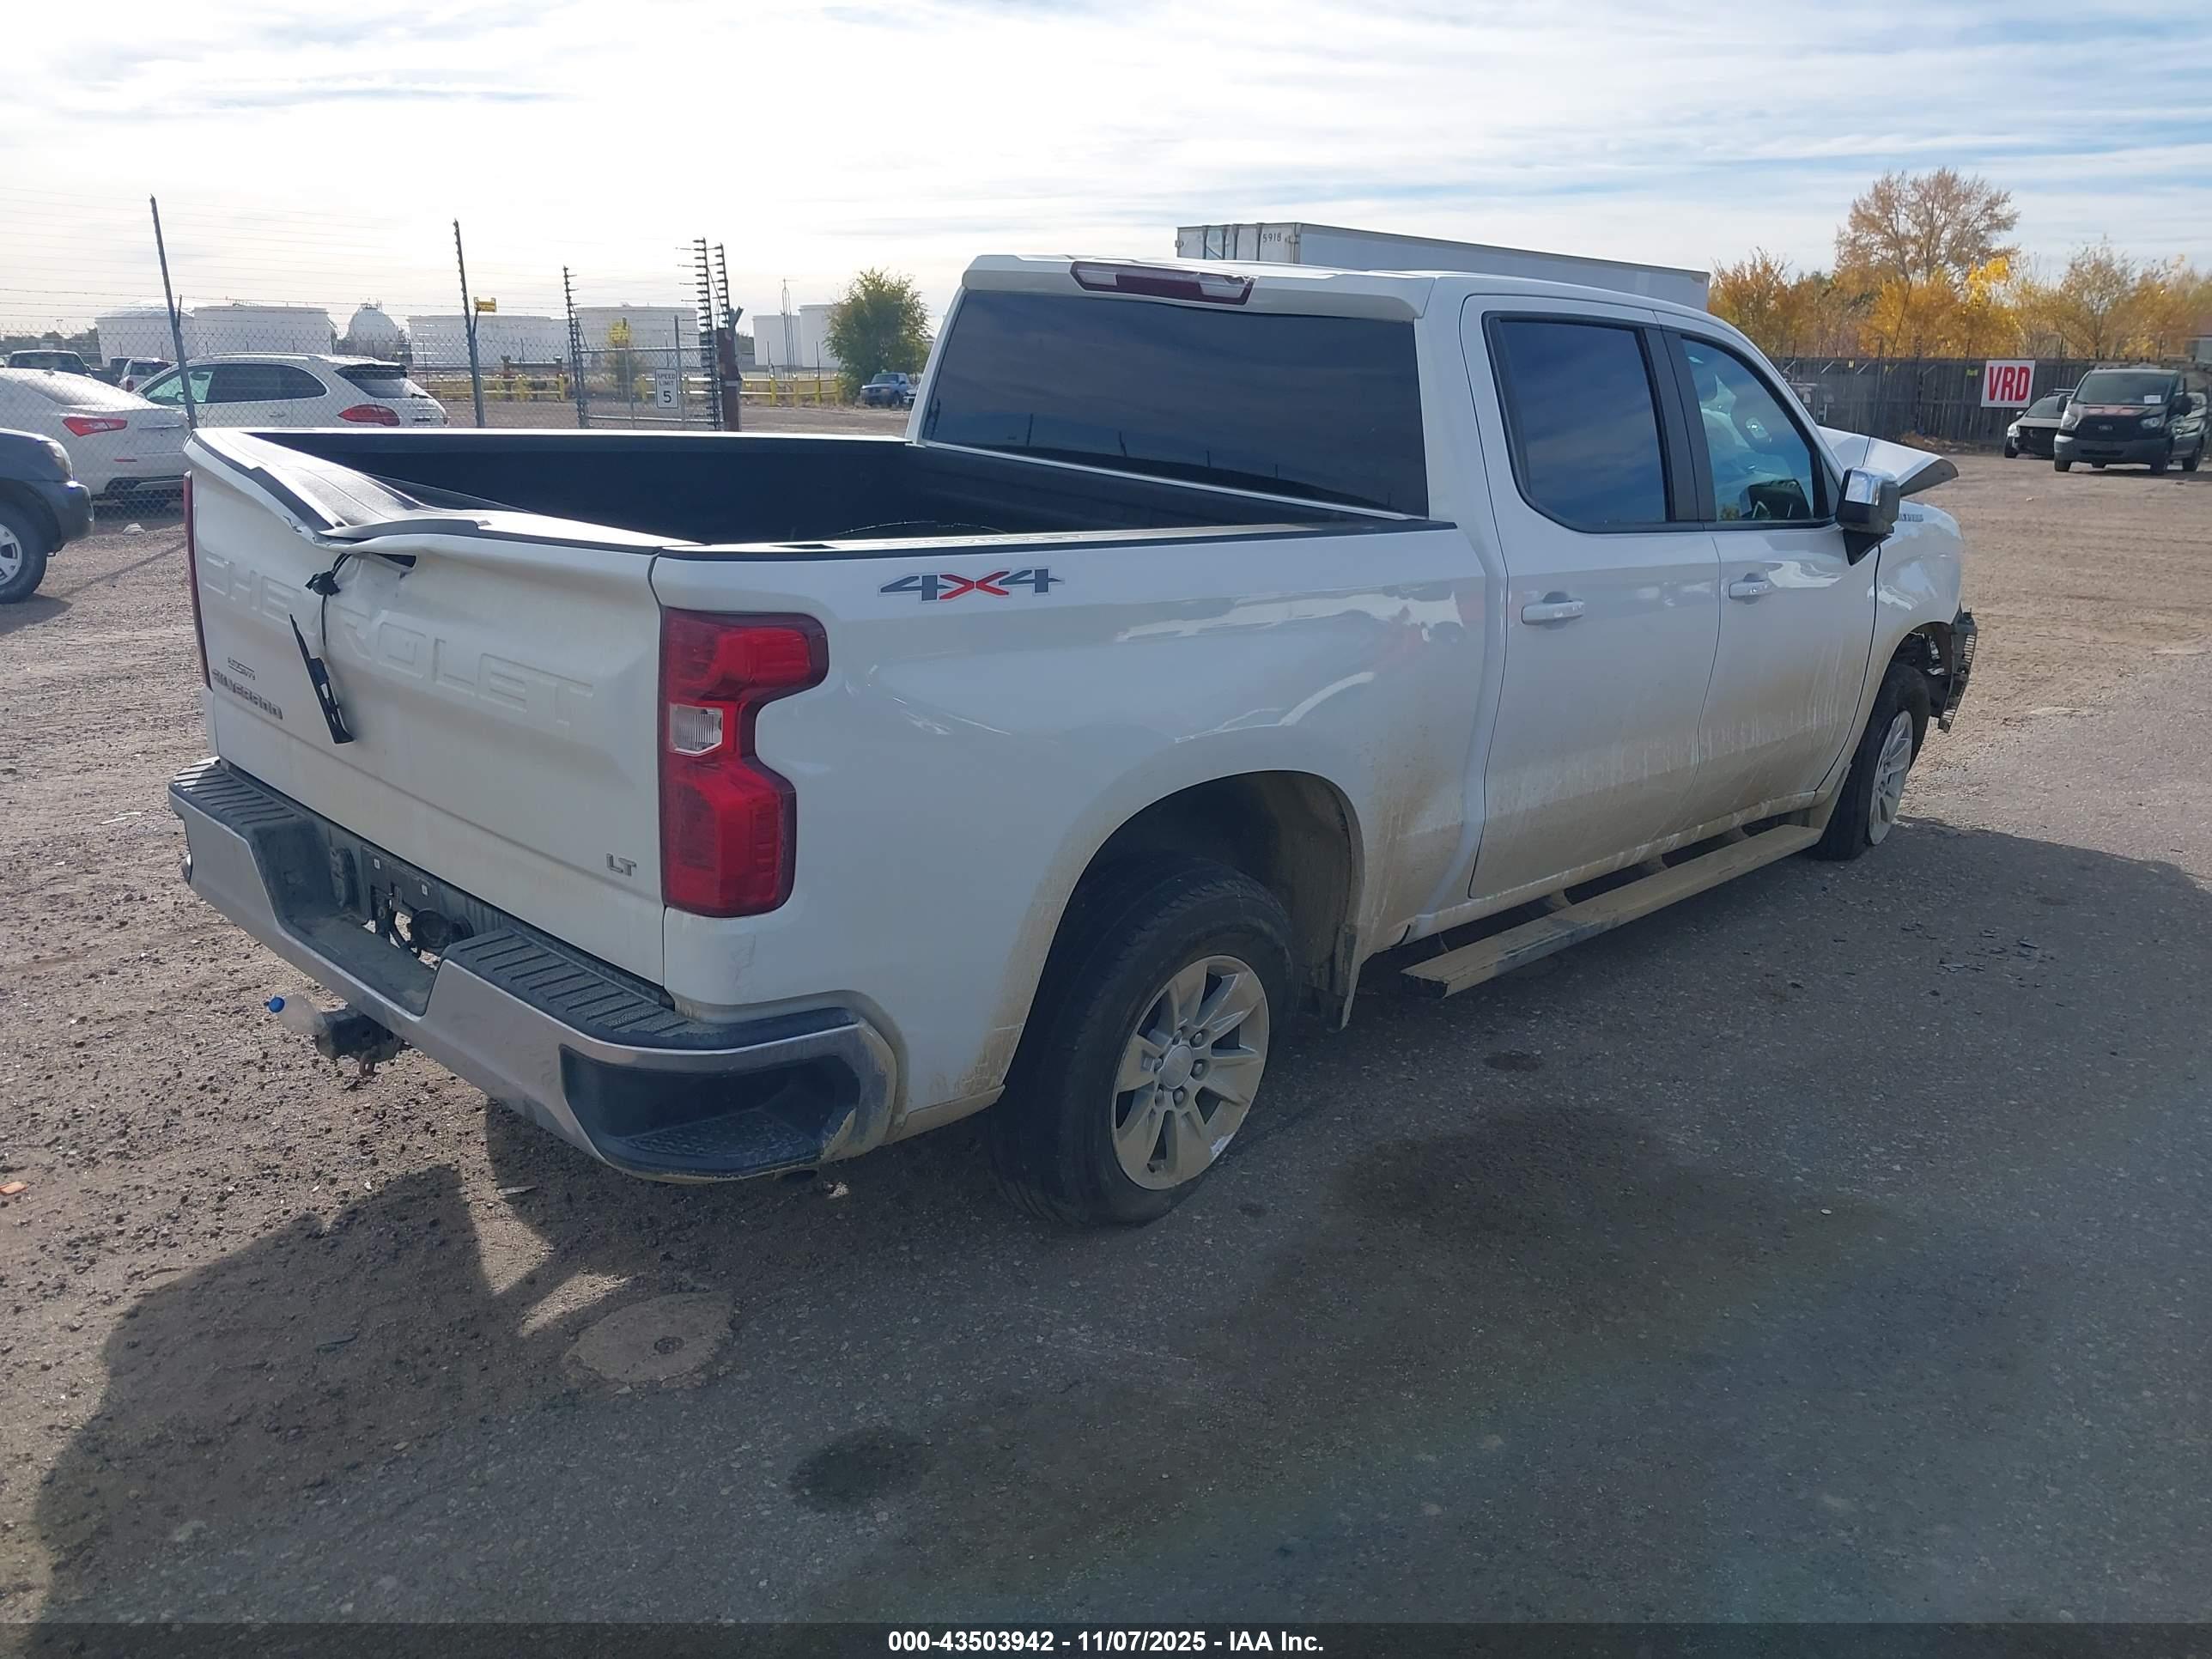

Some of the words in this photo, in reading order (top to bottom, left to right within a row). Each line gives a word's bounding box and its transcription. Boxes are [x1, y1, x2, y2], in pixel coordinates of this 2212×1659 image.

[1263, 233, 1281, 242] 5918
[1989, 366, 2030, 401] VRD
[663, 391, 672, 403] 5
[606, 853, 637, 876] LT
